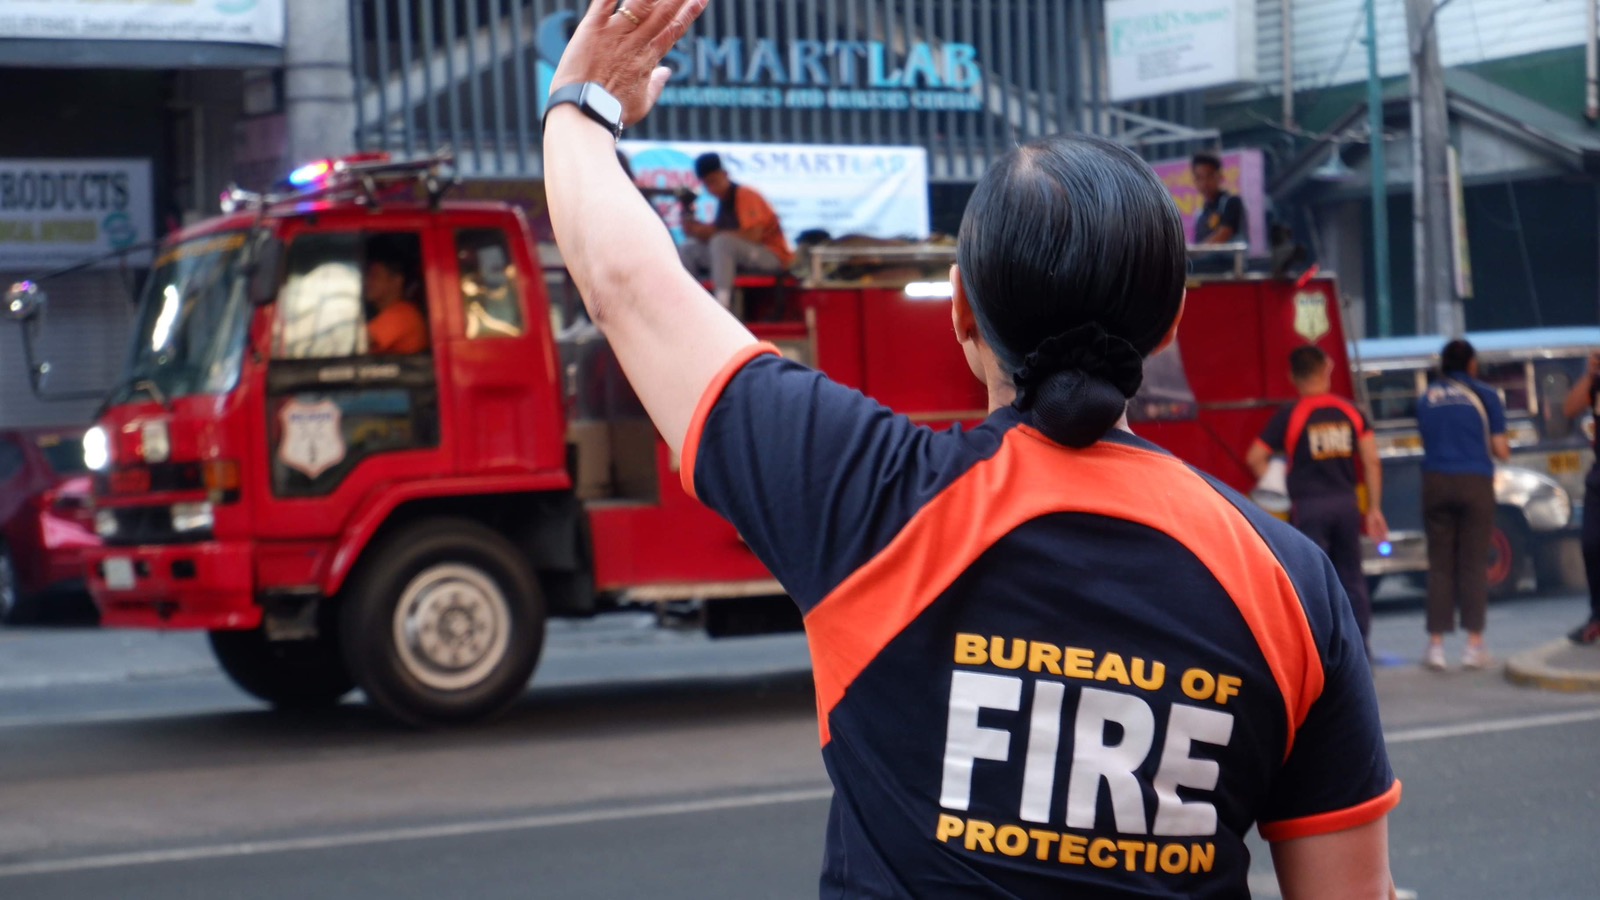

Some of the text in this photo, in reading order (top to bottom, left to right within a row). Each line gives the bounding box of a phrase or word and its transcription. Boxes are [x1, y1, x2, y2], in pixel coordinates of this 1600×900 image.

[953, 632, 1242, 704] BUREAU OF
[939, 670, 1234, 836] FIRE
[936, 814, 1215, 874] PROTECTION
